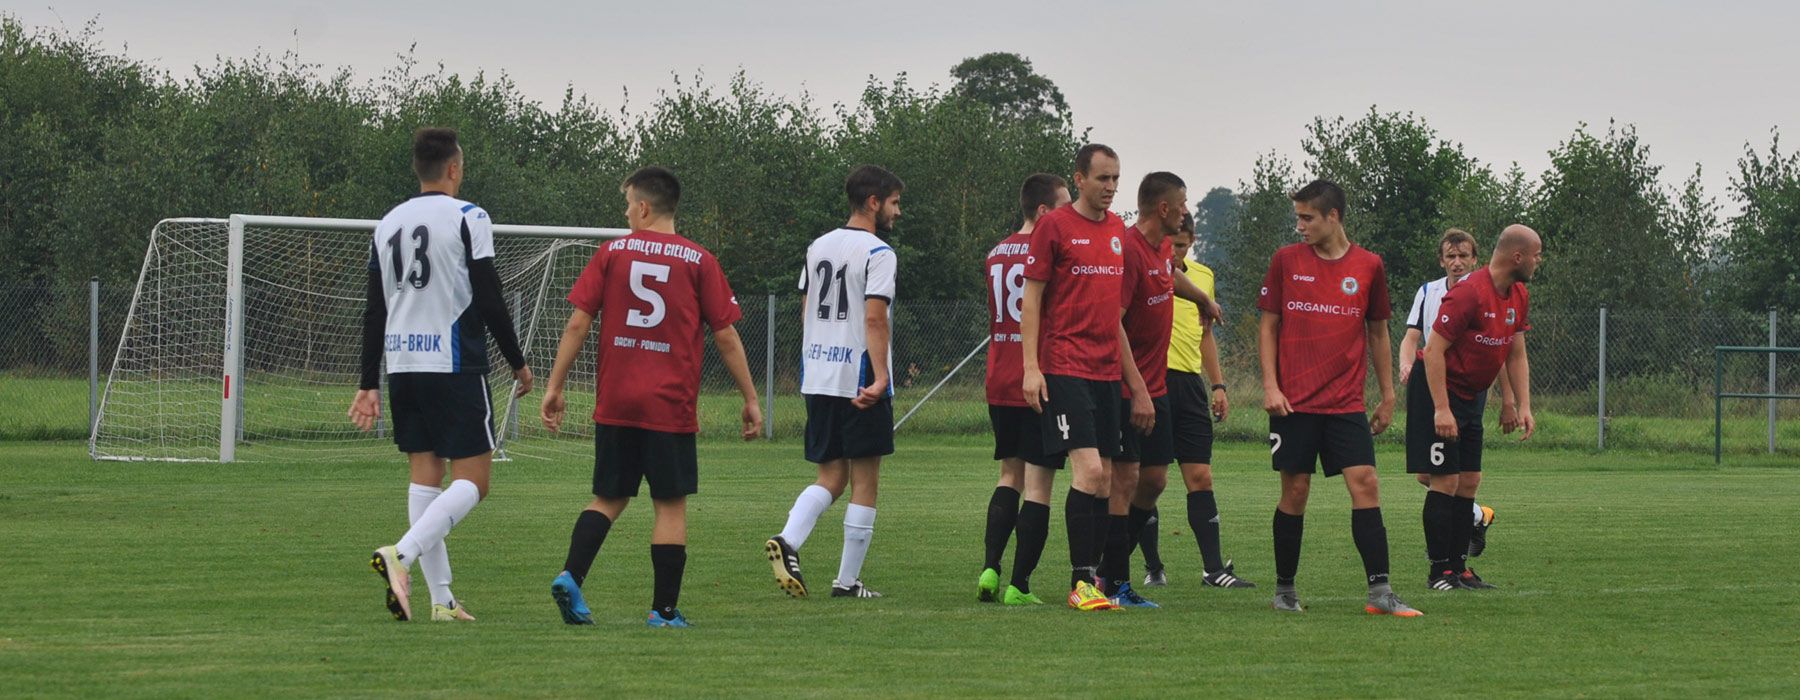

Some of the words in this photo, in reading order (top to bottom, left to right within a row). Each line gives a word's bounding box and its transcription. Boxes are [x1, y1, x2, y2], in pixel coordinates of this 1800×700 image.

[387, 224, 431, 290] 13
[627, 239, 662, 256] ORLĘTA
[626, 260, 671, 328] 5
[816, 259, 849, 321] 21
[990, 263, 1026, 323] 18
[1056, 413, 1070, 440] 4
[1430, 442, 1445, 466] 6
